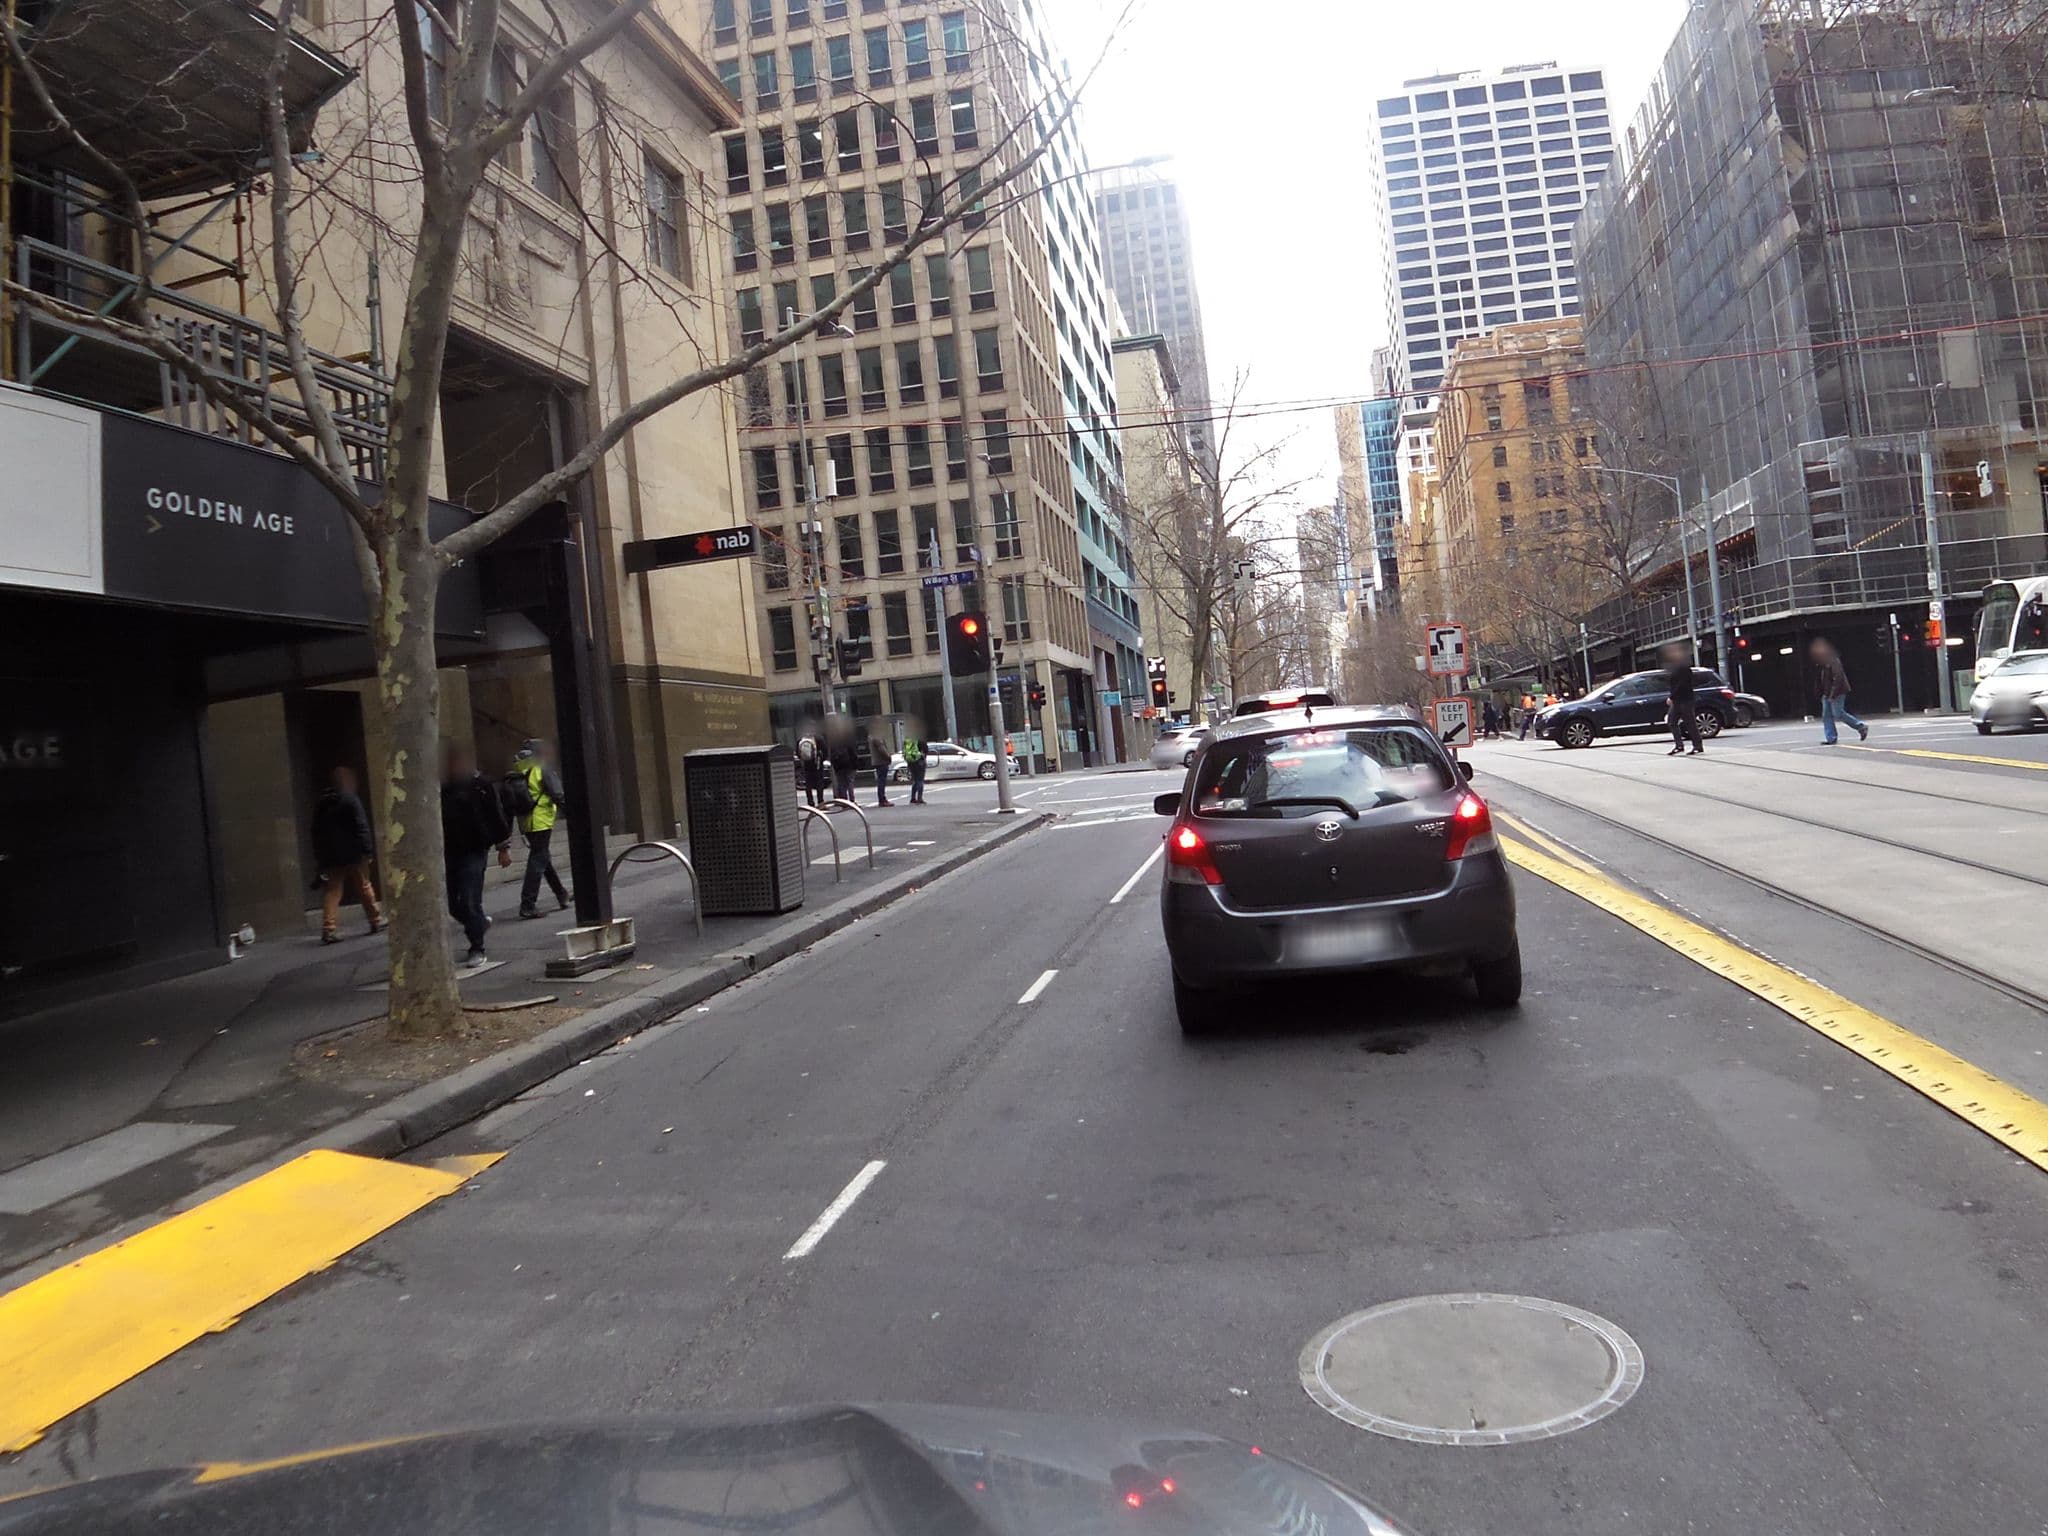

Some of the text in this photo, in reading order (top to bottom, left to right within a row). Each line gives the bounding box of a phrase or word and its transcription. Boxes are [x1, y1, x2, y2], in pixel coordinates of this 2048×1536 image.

[146, 487, 295, 535] GOLDEN AGE
[716, 530, 750, 550] nab
[1441, 704, 1464, 712] KEEP
[1442, 713, 1463, 722] LEFT
